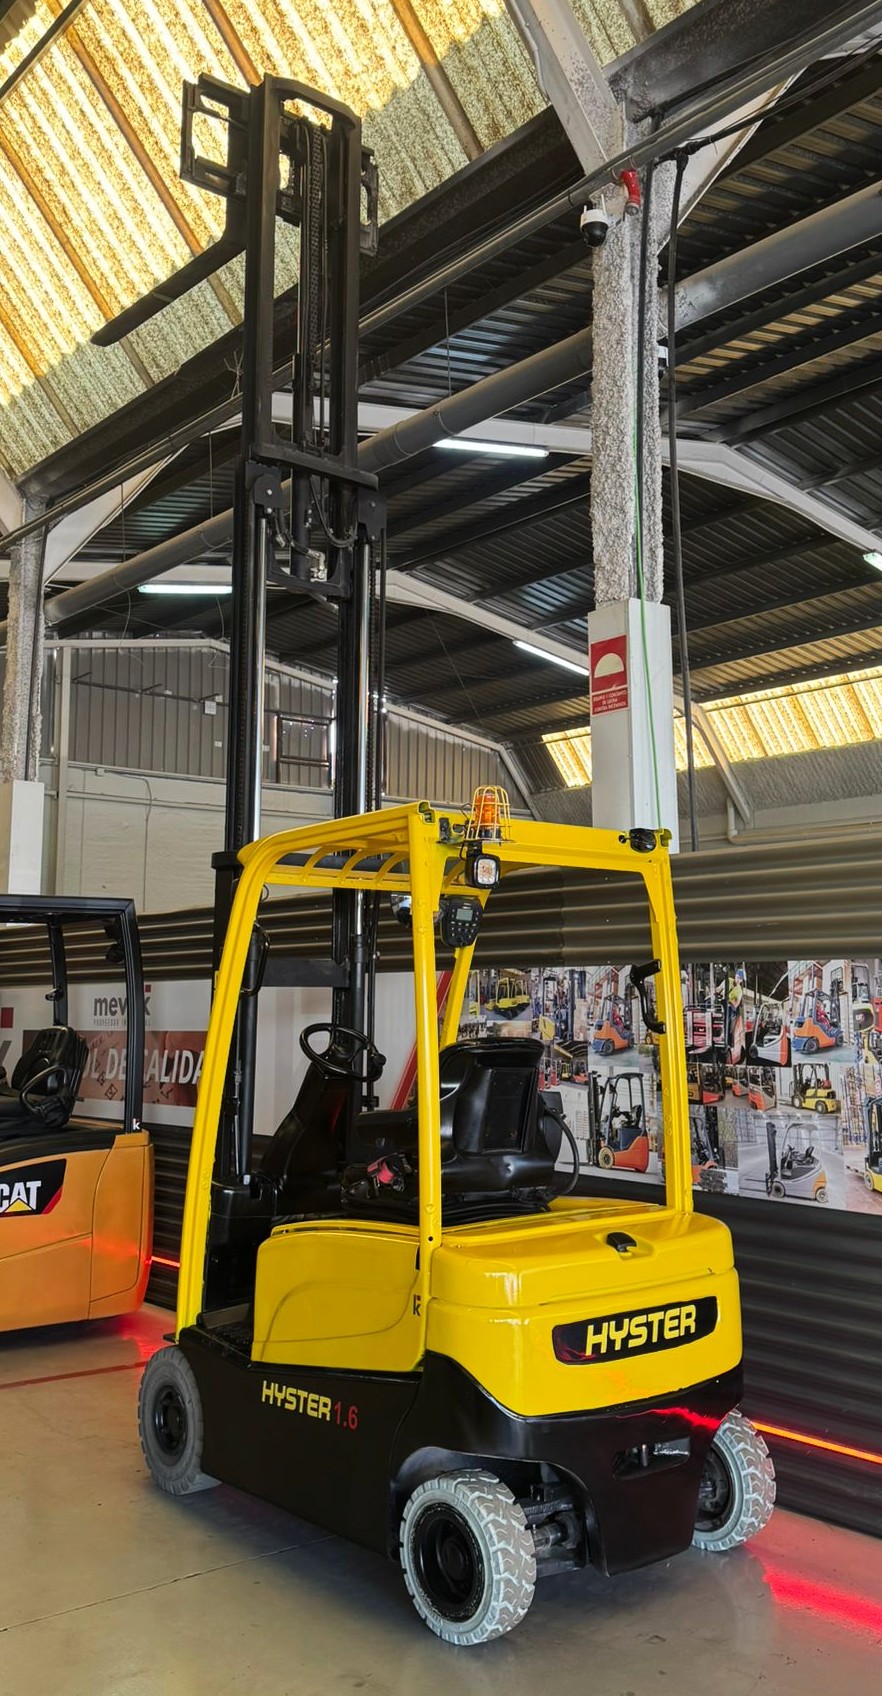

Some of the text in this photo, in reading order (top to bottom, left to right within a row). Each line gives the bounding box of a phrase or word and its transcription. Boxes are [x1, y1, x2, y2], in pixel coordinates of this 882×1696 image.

[585, 1304, 697, 1356] HYSTER
[261, 1380, 358, 1430] HYSTER 1.6
